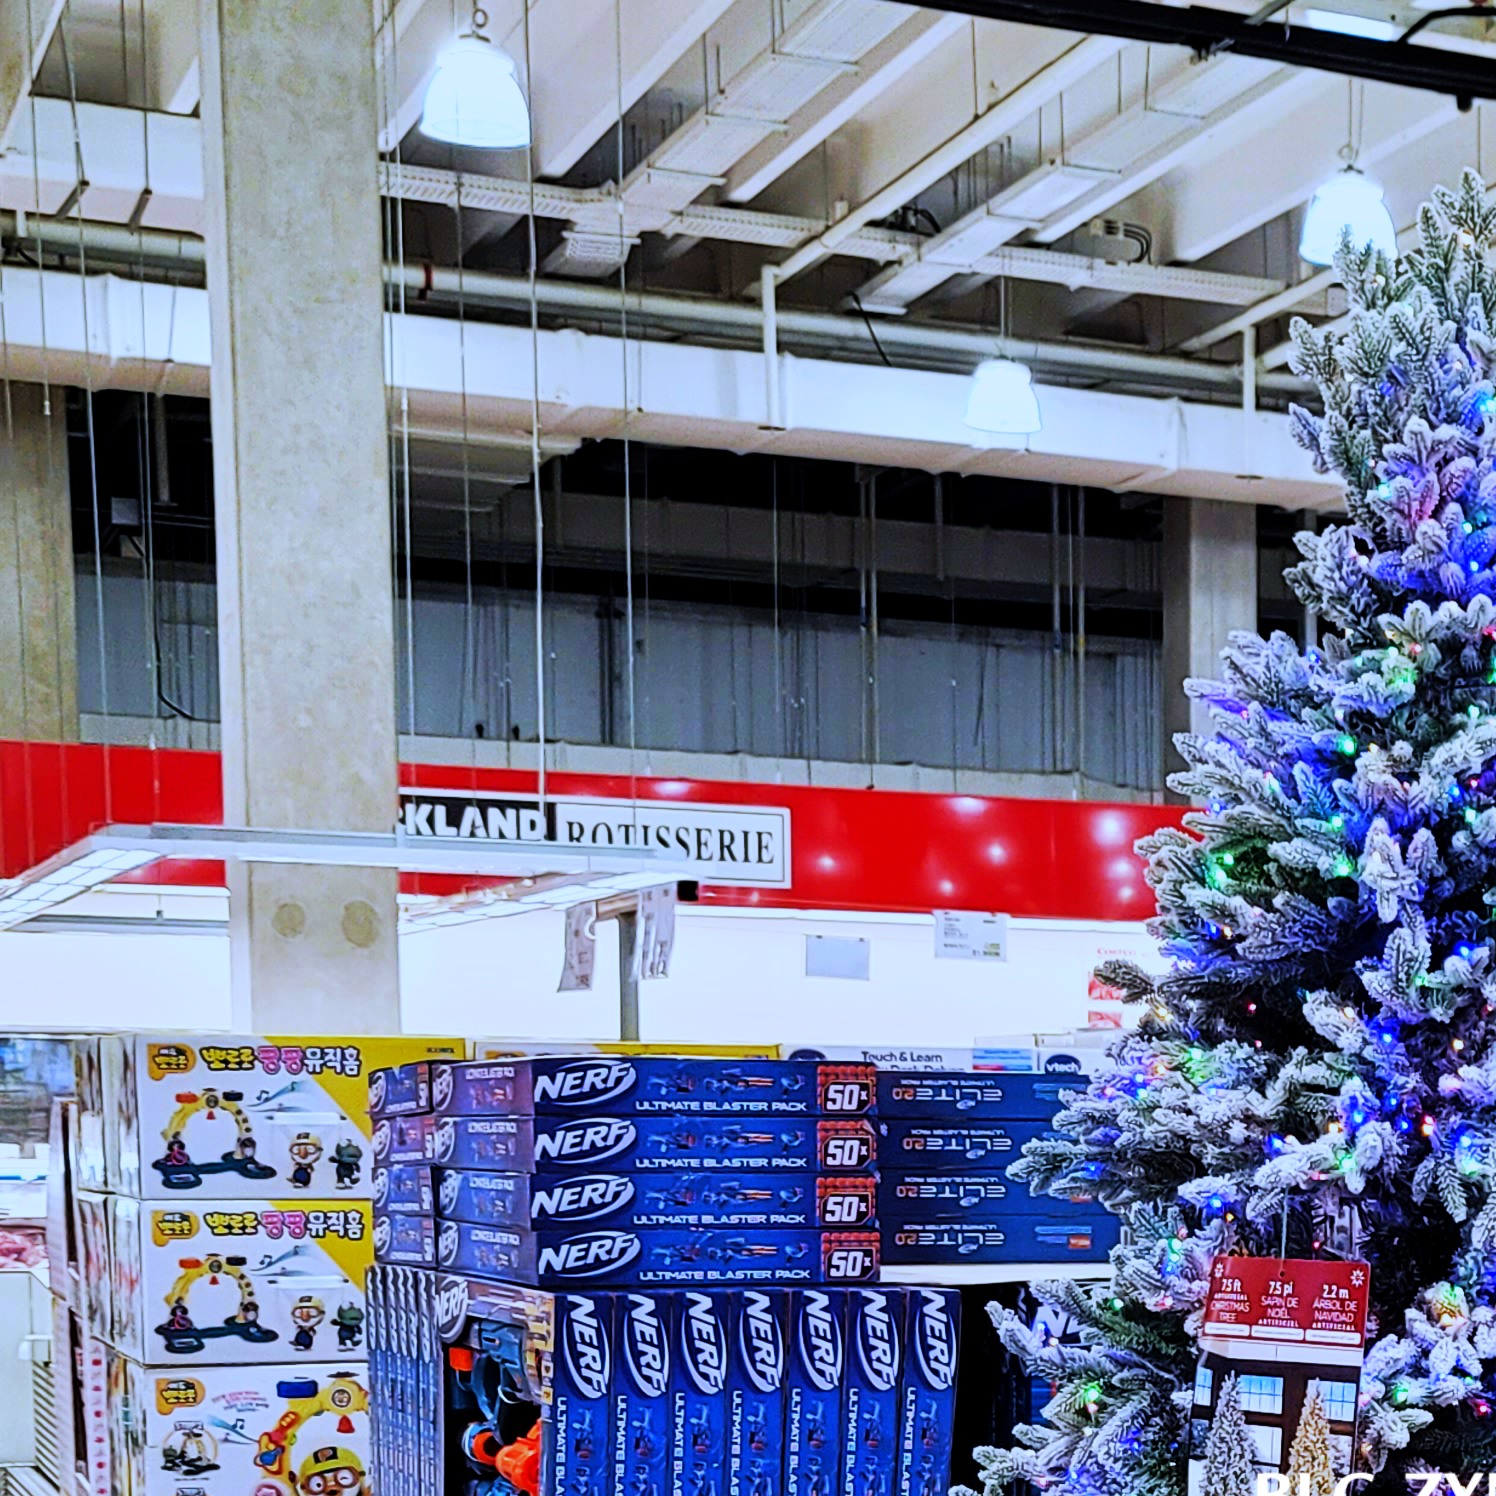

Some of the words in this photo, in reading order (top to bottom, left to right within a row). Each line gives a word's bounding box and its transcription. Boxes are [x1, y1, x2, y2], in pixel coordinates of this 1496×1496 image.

[910, 1051, 943, 1063] Learn
[535, 1061, 632, 1104] NERF
[636, 1100, 700, 1112] ULTIMATE
[704, 1101, 768, 1112] BLASTER
[771, 1102, 806, 1112] PACK
[535, 1119, 632, 1161] NERF
[538, 1232, 637, 1275] NERF
[640, 1271, 704, 1281] ULTIMATE
[707, 1270, 772, 1280] BLASTER
[775, 1269, 810, 1279] PACK
[1314, 1311, 1355, 1322] NAVIDAD
[567, 1295, 608, 1397] NERF
[685, 1292, 726, 1395] NERF
[745, 1291, 783, 1393] NERF
[921, 1290, 957, 1390] NERF
[556, 1397, 567, 1463] ULTIMATE
